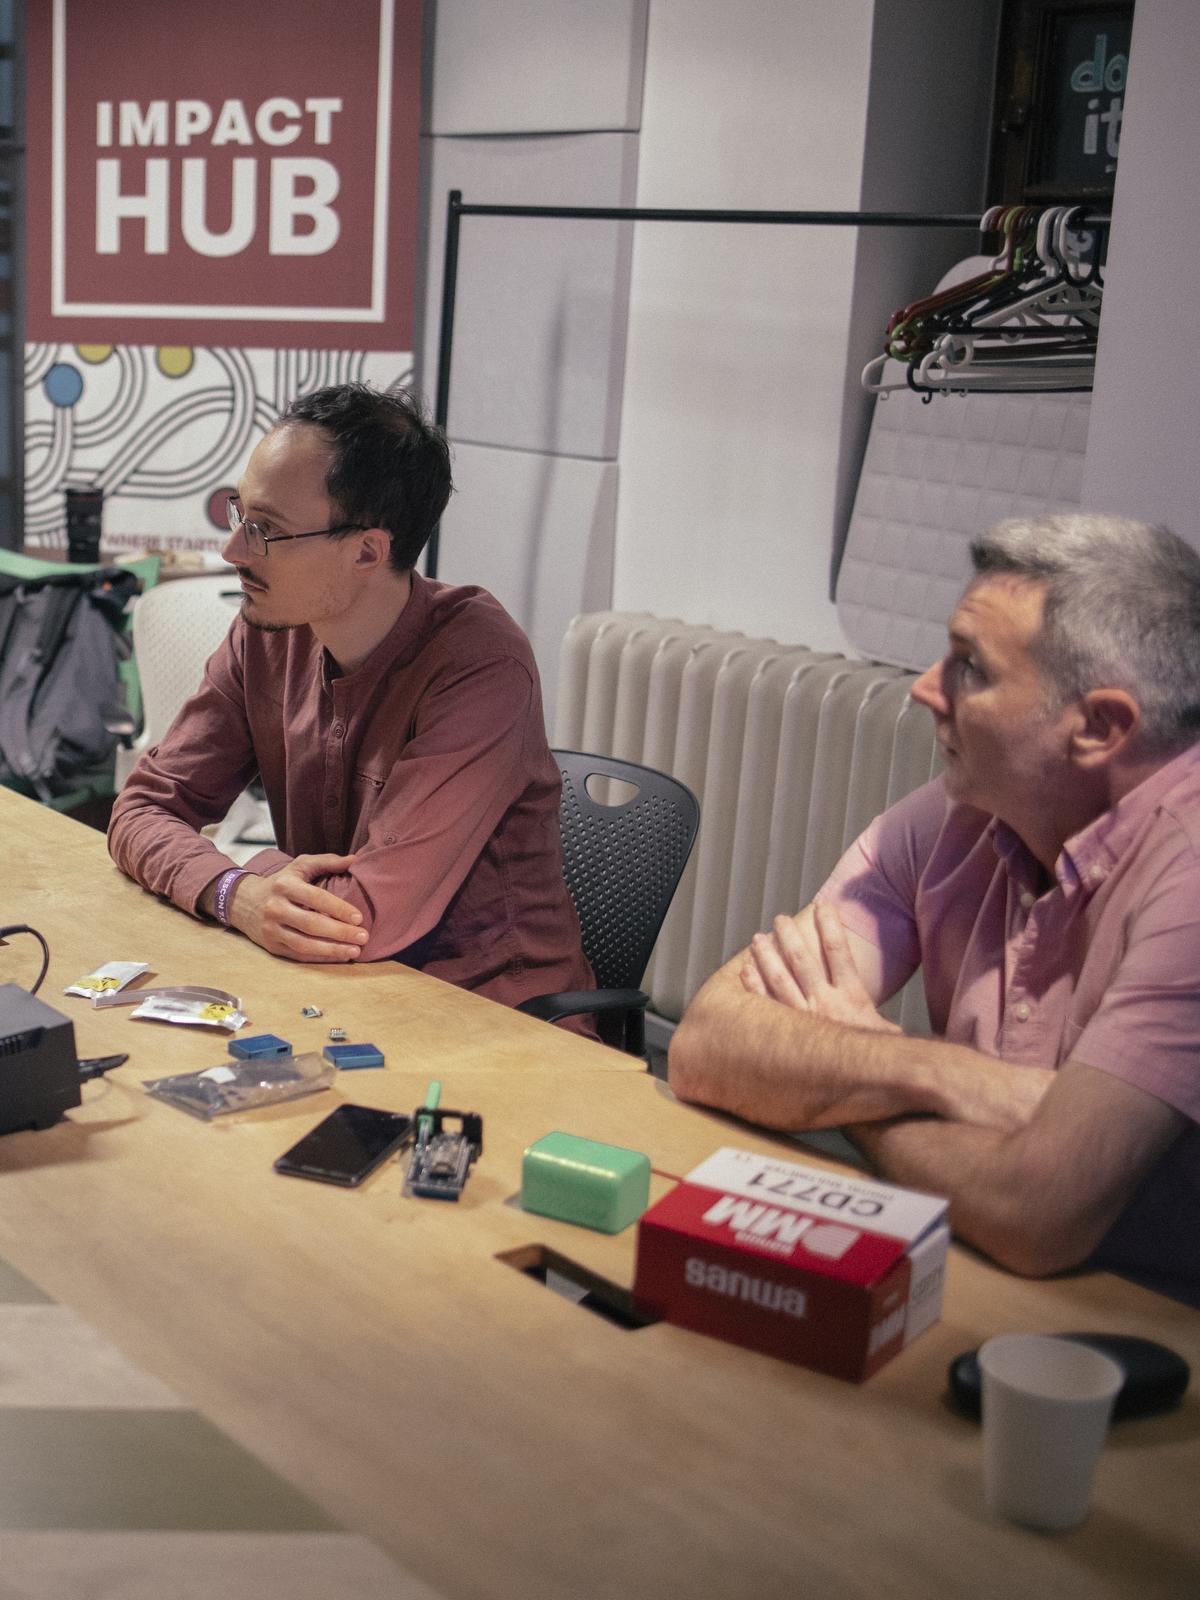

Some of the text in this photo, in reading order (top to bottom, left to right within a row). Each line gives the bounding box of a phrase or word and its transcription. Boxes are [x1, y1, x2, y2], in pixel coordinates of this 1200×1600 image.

[1070, 34, 1128, 92] do
[97, 97, 343, 147] IMPACT
[1083, 98, 1122, 158] it
[96, 157, 340, 257] HUB
[746, 1171, 884, 1218] CD771
[685, 1257, 807, 1319] sanwa
